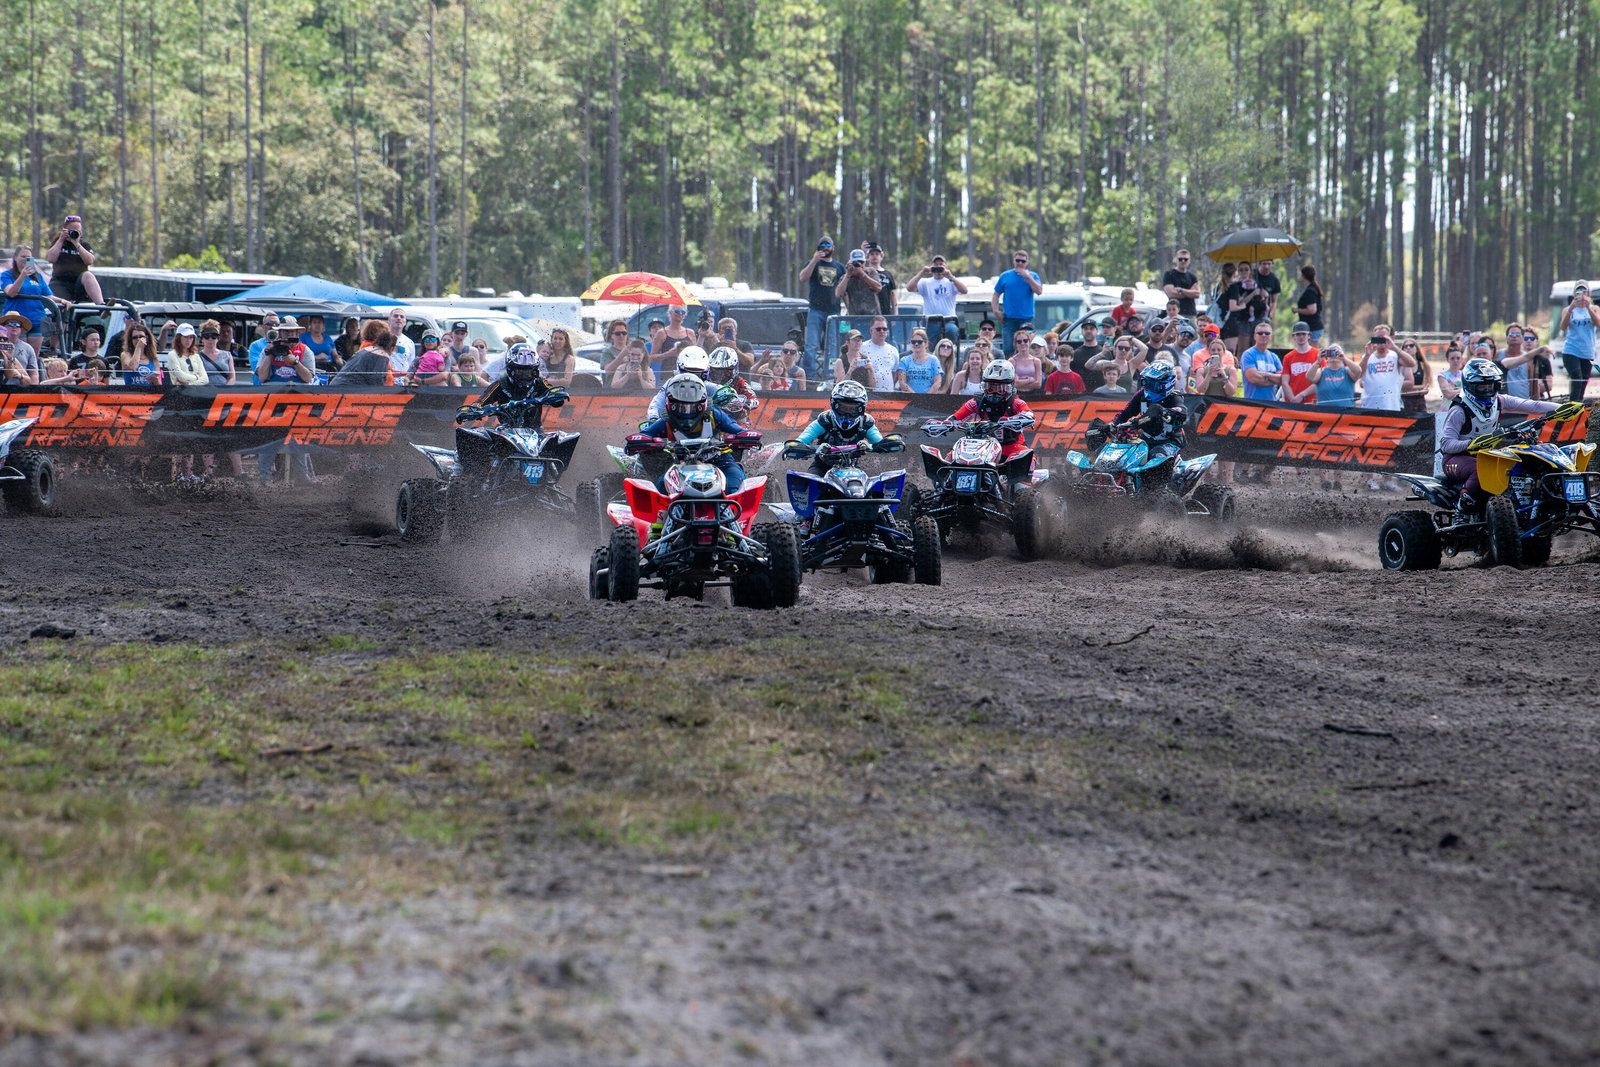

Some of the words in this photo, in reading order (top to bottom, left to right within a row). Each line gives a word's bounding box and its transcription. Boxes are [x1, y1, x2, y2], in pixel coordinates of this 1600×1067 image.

[0, 394, 164, 427] OOSE
[202, 394, 415, 427] MOOSE
[25, 429, 144, 446] RACING
[283, 428, 394, 445] RACING
[1197, 403, 1418, 449] MOOSE
[1277, 442, 1394, 465] RACING
[1566, 482, 1584, 496] 418
